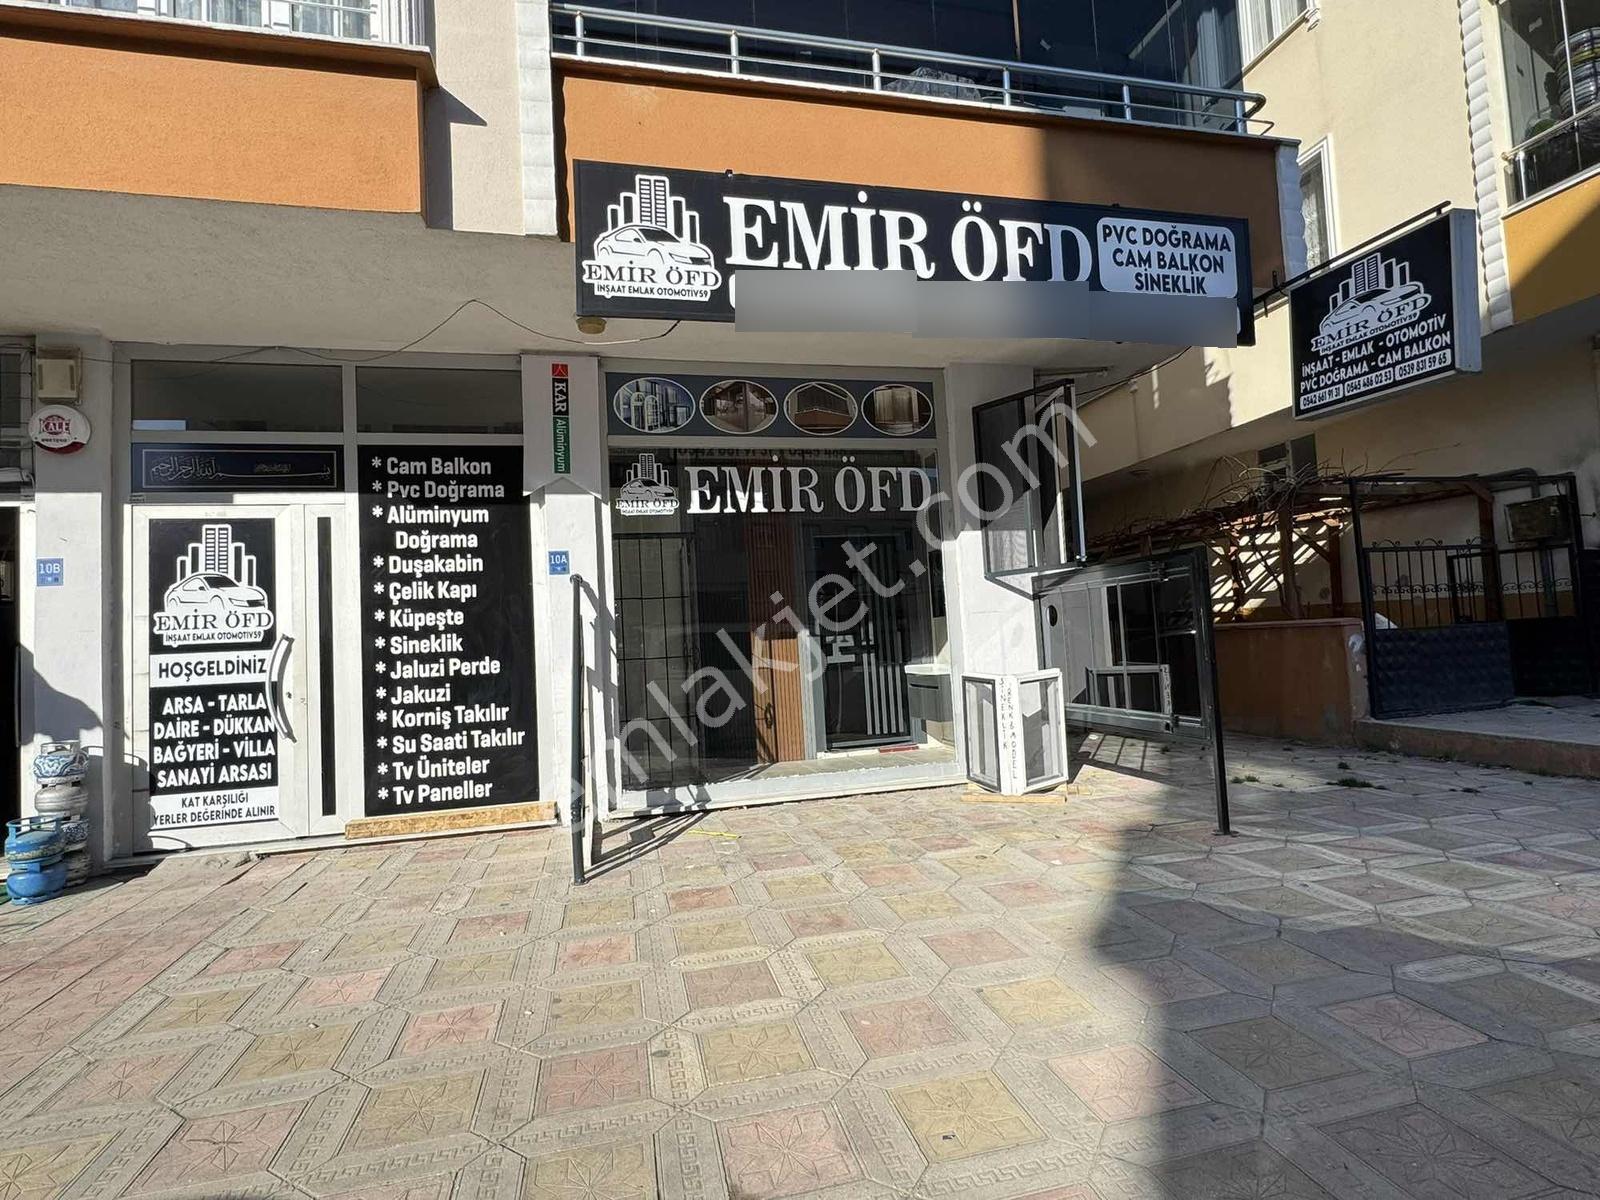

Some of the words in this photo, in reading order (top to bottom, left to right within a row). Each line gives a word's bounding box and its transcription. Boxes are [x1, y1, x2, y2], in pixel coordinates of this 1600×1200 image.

[723, 191, 935, 279] EMİR
[951, 200, 1092, 282] ÖFD
[1102, 224, 1137, 245] PVC
[1142, 225, 1231, 252] DOĞRAMA
[1112, 248, 1152, 268] CAM
[1157, 251, 1224, 274] BALKON
[586, 261, 657, 284] EMİR
[666, 266, 719, 287] ÖFD
[1134, 269, 1207, 295] SİNEKLİK
[597, 284, 625, 295] İNŞAAT
[628, 286, 654, 295] EMLAK
[1302, 356, 1333, 377] İNŞAAT
[1342, 341, 1374, 363] EMLAK
[1386, 313, 1446, 347] OTOMOTİV
[1315, 320, 1370, 347] EMİR
[1300, 377, 1317, 393] PVC
[1319, 360, 1369, 387] DOĞRAMA
[1377, 348, 1402, 367] CAM
[1404, 331, 1451, 359] BALKON
[1398, 362, 1415, 378] 0539
[1428, 355, 1436, 368] 59
[1438, 352, 1447, 365] 65
[1374, 373, 1383, 385] 02
[1384, 370, 1392, 382] 53
[554, 382, 567, 412] KAR
[555, 418, 568, 473] Alüminyum
[386, 457, 427, 475] Cam
[431, 457, 492, 475] Balkon
[387, 481, 421, 498] Pvc
[424, 480, 505, 502] Doğrama
[685, 454, 824, 514] EMİR
[834, 455, 932, 513] ÖFD
[387, 505, 489, 527] Alüminyum
[395, 530, 478, 553] Doğrama
[39, 563, 61, 574] 10B
[389, 554, 484, 578] Duşakabin
[550, 554, 567, 564] 10A
[389, 581, 435, 606] Çelik
[437, 581, 477, 603] Kapı
[156, 609, 218, 631] EMİR
[226, 611, 272, 628] ÖFD
[389, 607, 465, 632] Küpeşte
[193, 632, 215, 640] EMLAK
[390, 633, 464, 655] Sineklik
[159, 655, 267, 682] HOŞGELDİNİZ
[390, 659, 445, 680] Jaluzi
[449, 656, 501, 677] Perde
[162, 696, 205, 715] ARSA
[218, 692, 267, 711] TARLA
[391, 683, 451, 705] Jakuzi
[154, 717, 199, 740] DAİRE
[213, 714, 275, 736] DÜKKAN
[391, 706, 452, 730] Korniş
[454, 703, 510, 724] Takılır
[154, 738, 219, 764] BAĞYERİ
[233, 736, 275, 758] VİLLA
[392, 735, 417, 754] Su
[420, 730, 468, 752] Saati
[470, 727, 526, 748] Takılır
[157, 762, 215, 787] SANAYİ
[218, 762, 272, 783] ARSASI
[392, 762, 414, 780] Tv
[417, 755, 490, 779] Üniteler
[181, 797, 200, 808] KAT
[203, 791, 248, 807] KARŞILIĞI
[392, 786, 414, 805] Tv
[418, 780, 493, 803] Paneller
[154, 813, 187, 826] YERLER
[190, 806, 243, 823] DEĞERİNDE
[245, 805, 275, 818] ALINIR
